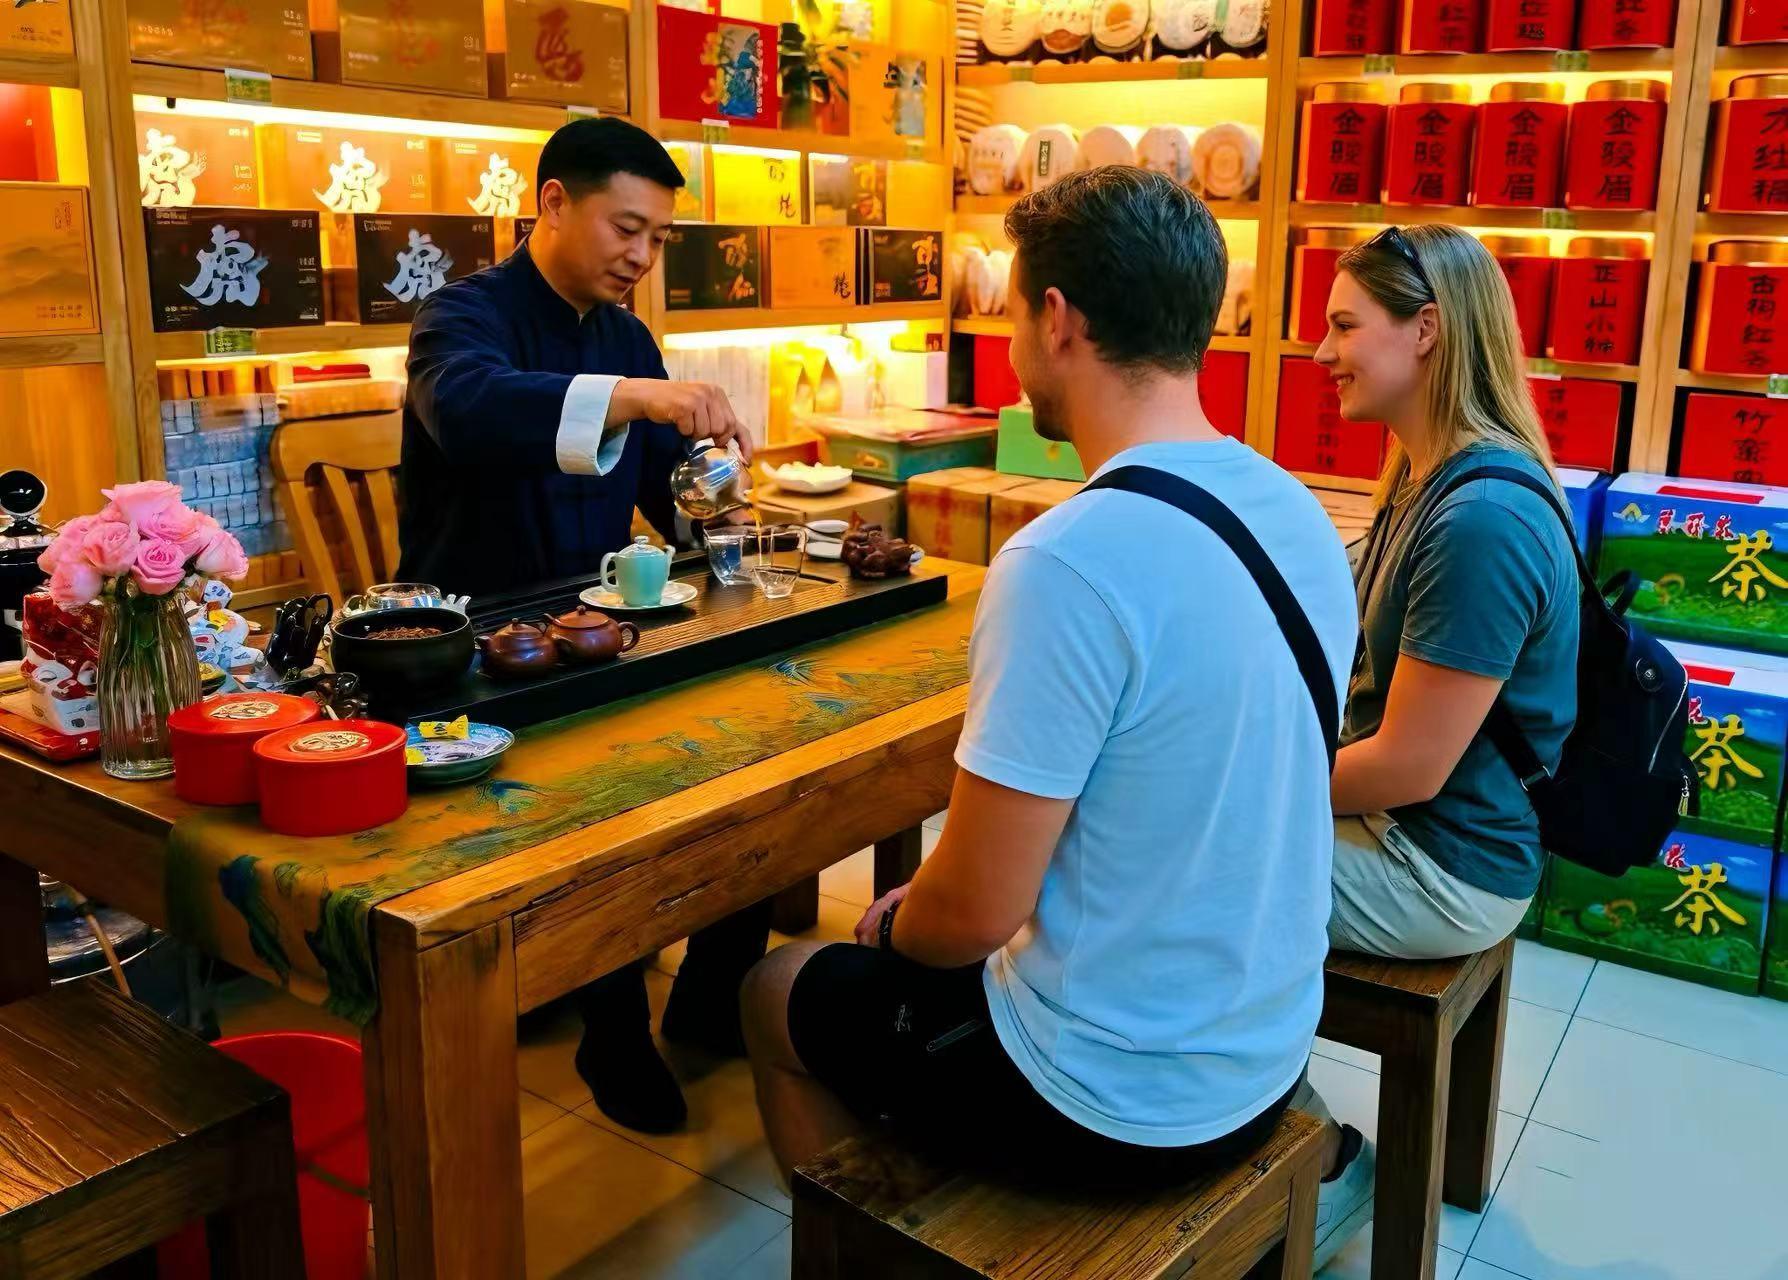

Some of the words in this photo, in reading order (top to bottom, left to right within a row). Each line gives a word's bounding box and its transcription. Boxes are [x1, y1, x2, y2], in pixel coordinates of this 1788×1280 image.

[179, 224, 269, 307] 虎
[380, 228, 454, 303] 虎
[1708, 529, 1788, 603] 茶
[1689, 714, 1765, 791] 茶
[1661, 862, 1748, 936] 茶
